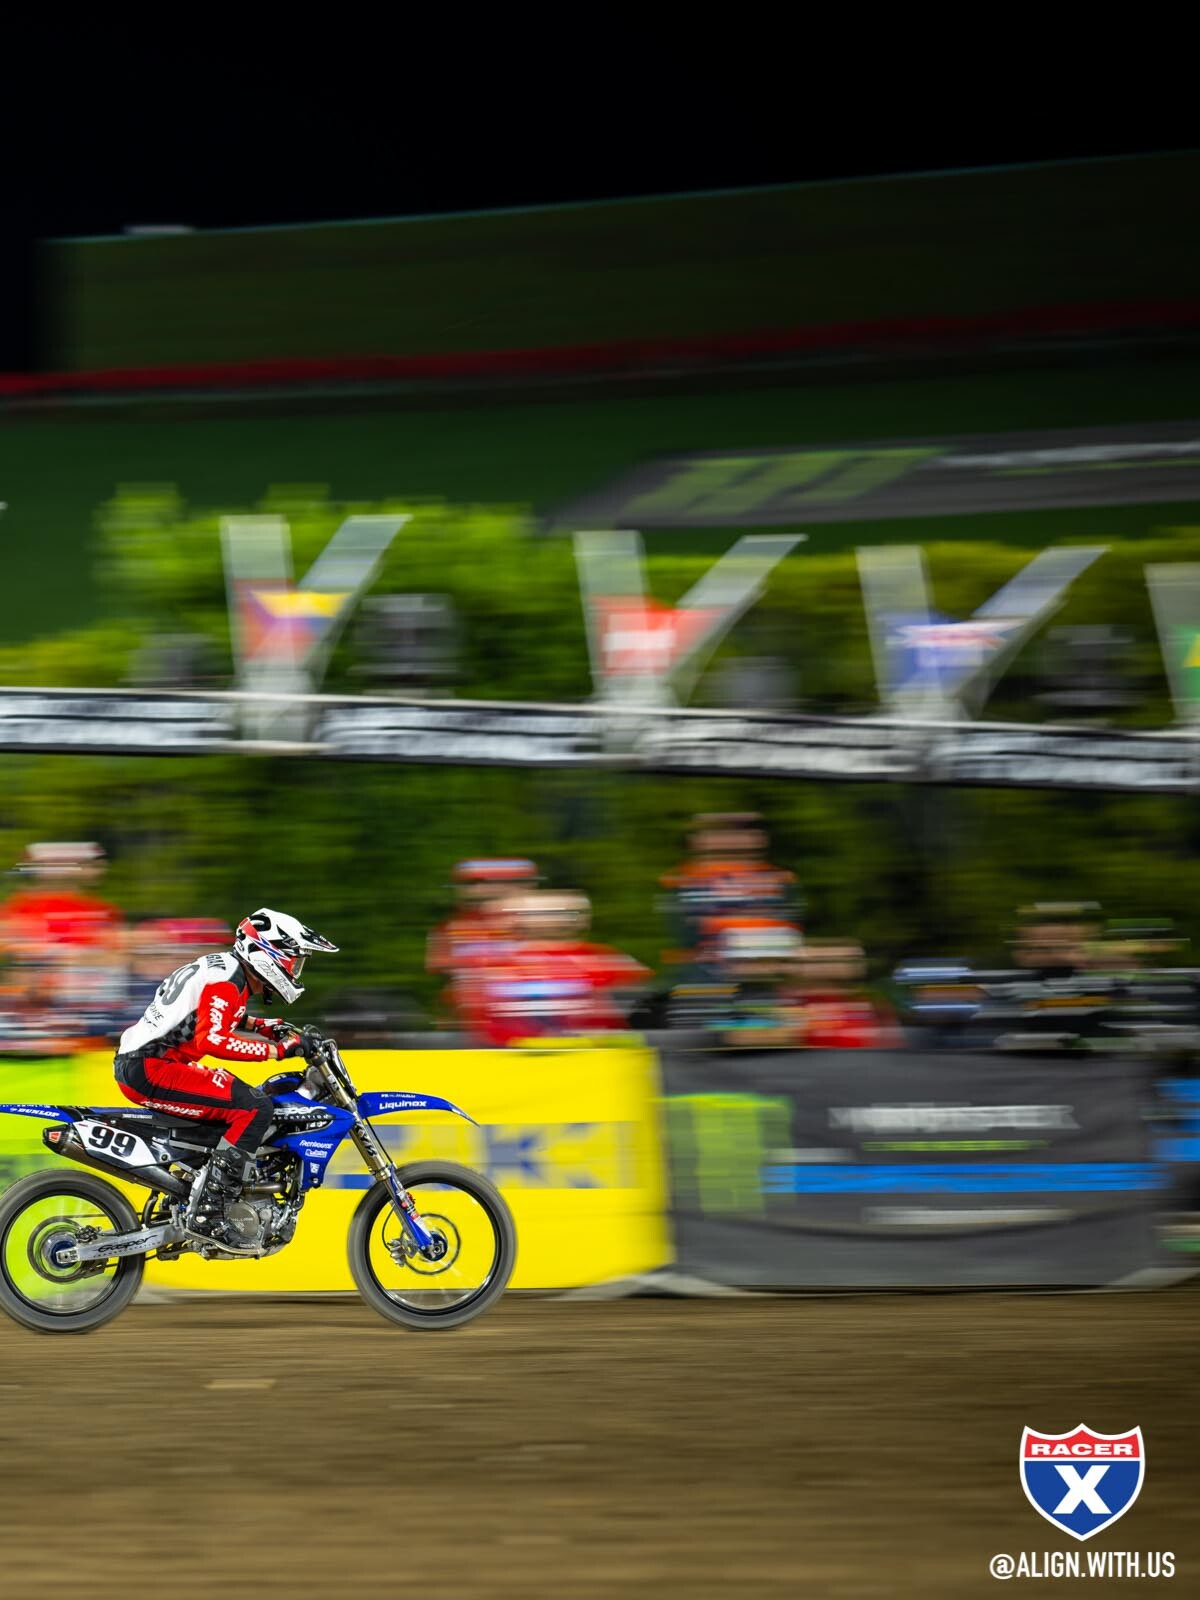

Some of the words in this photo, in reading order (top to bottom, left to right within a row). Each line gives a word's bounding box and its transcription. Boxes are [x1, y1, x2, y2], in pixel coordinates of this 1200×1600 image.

[159, 964, 201, 1006] 9
[17, 1108, 60, 1118] DUNLOP
[88, 1126, 137, 1158] 99
